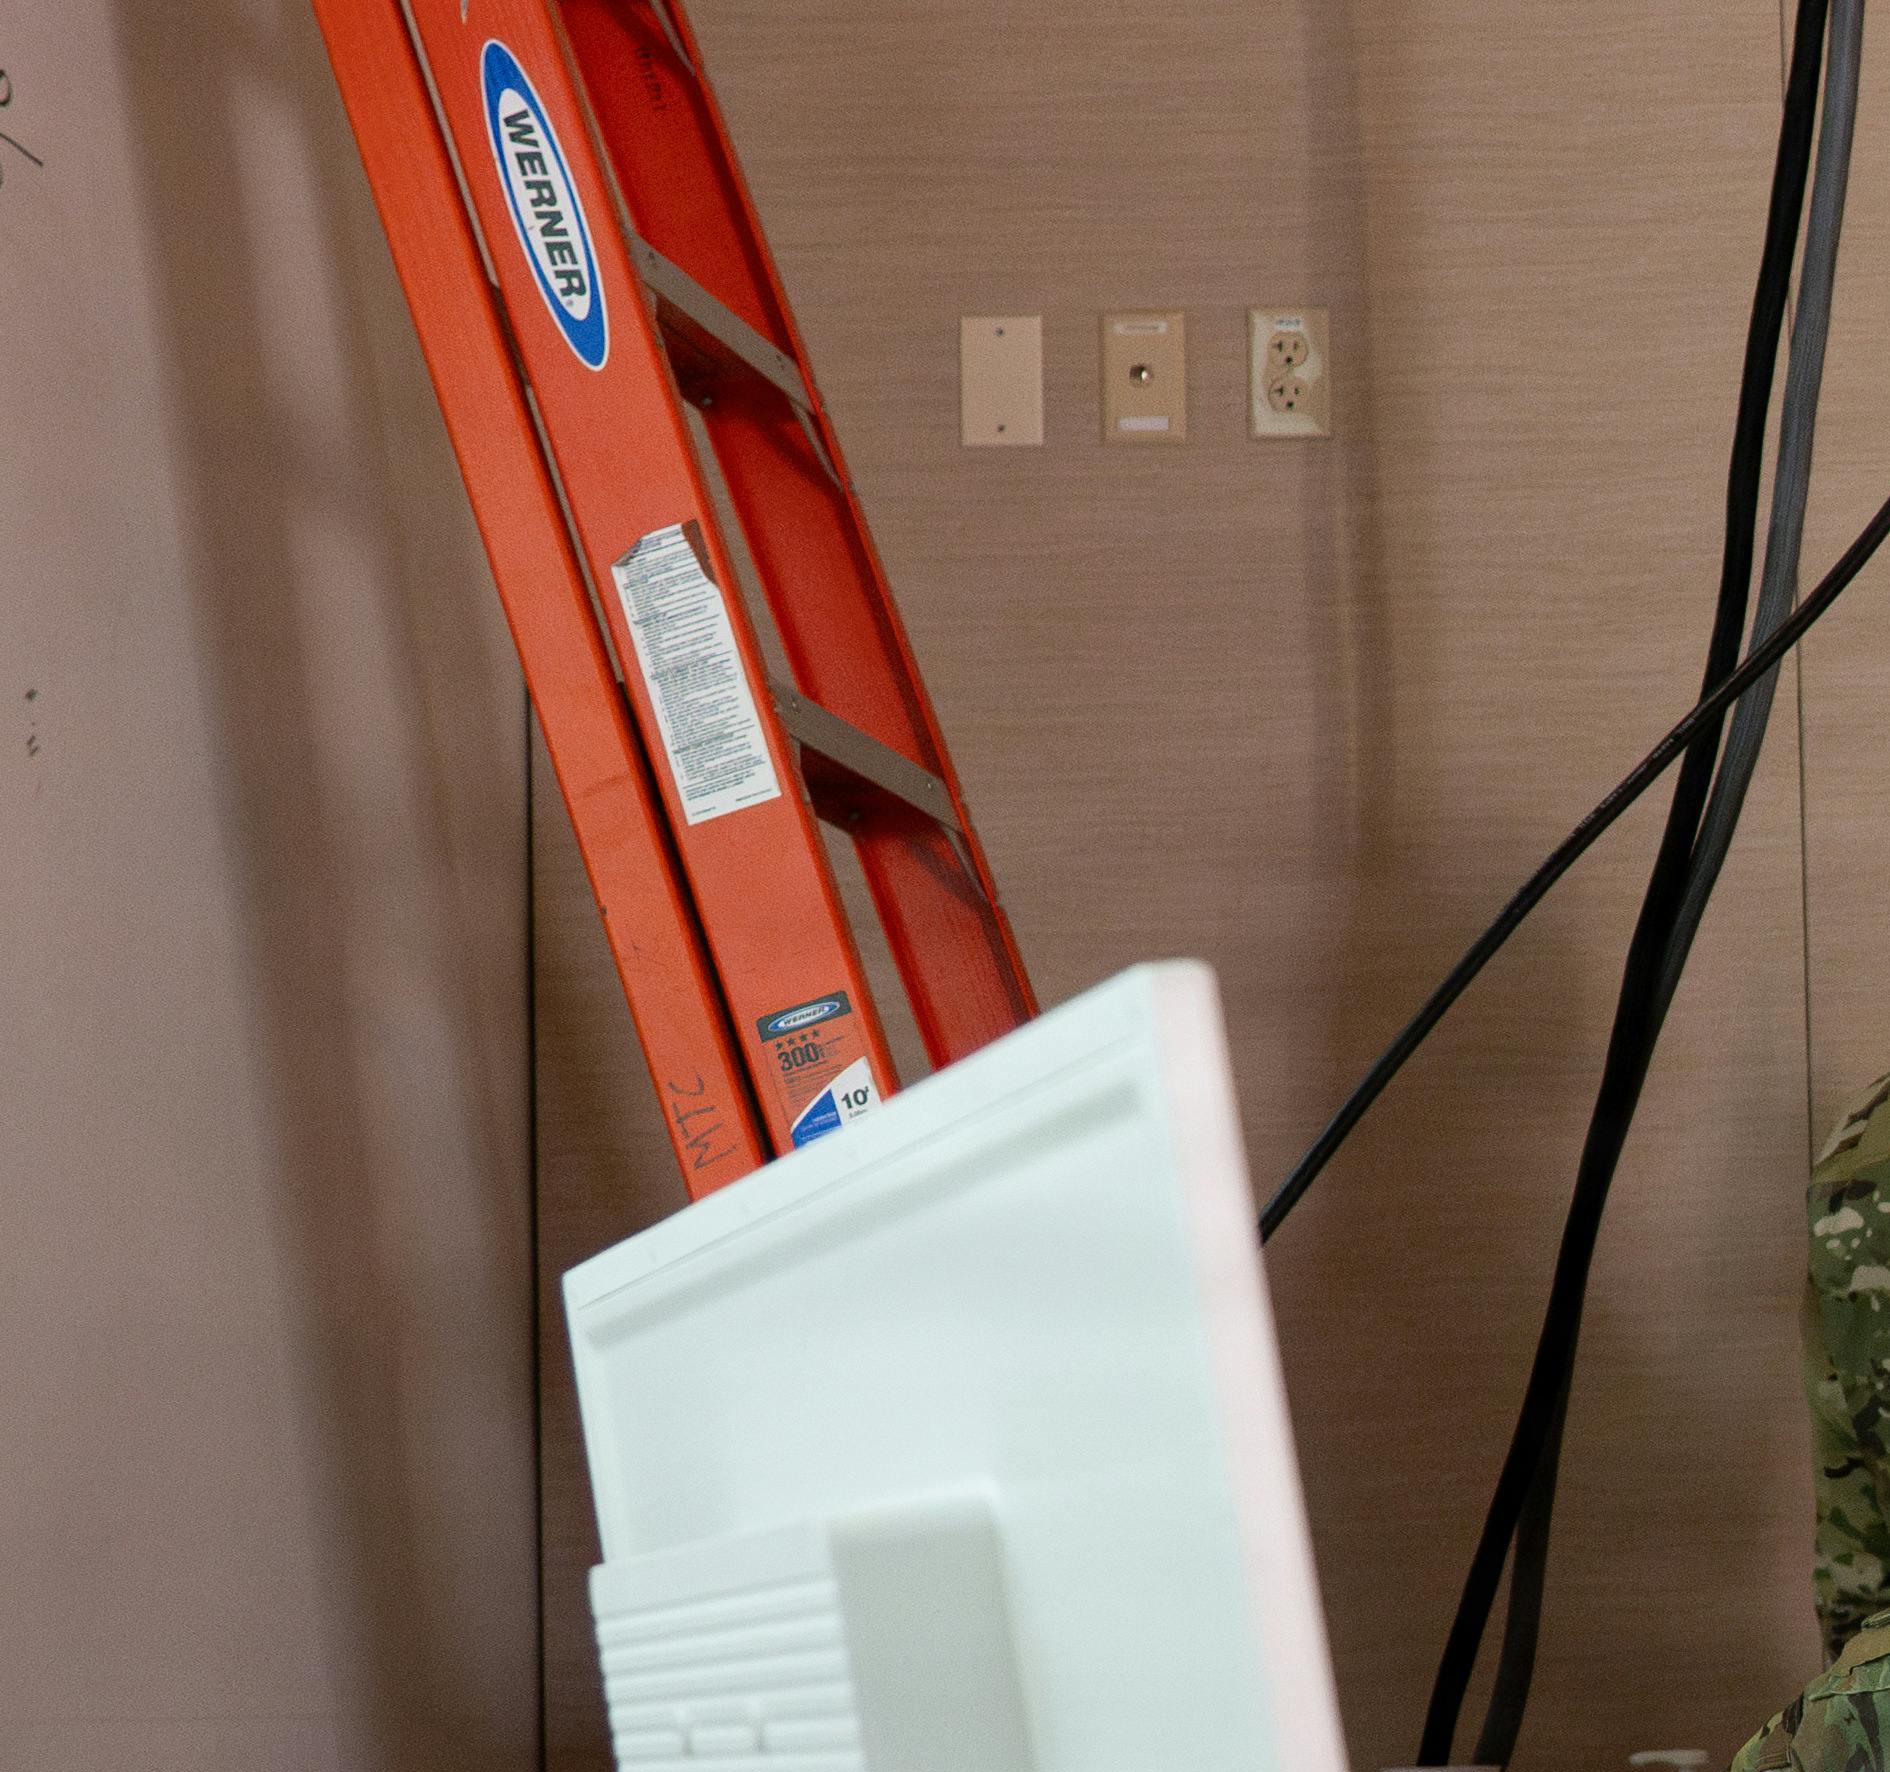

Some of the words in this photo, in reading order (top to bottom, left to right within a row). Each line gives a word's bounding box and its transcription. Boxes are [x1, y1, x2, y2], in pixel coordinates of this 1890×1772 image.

[503, 109, 588, 299] WERNER
[782, 1005, 826, 1027] WERNER
[777, 1042, 820, 1073] 300
